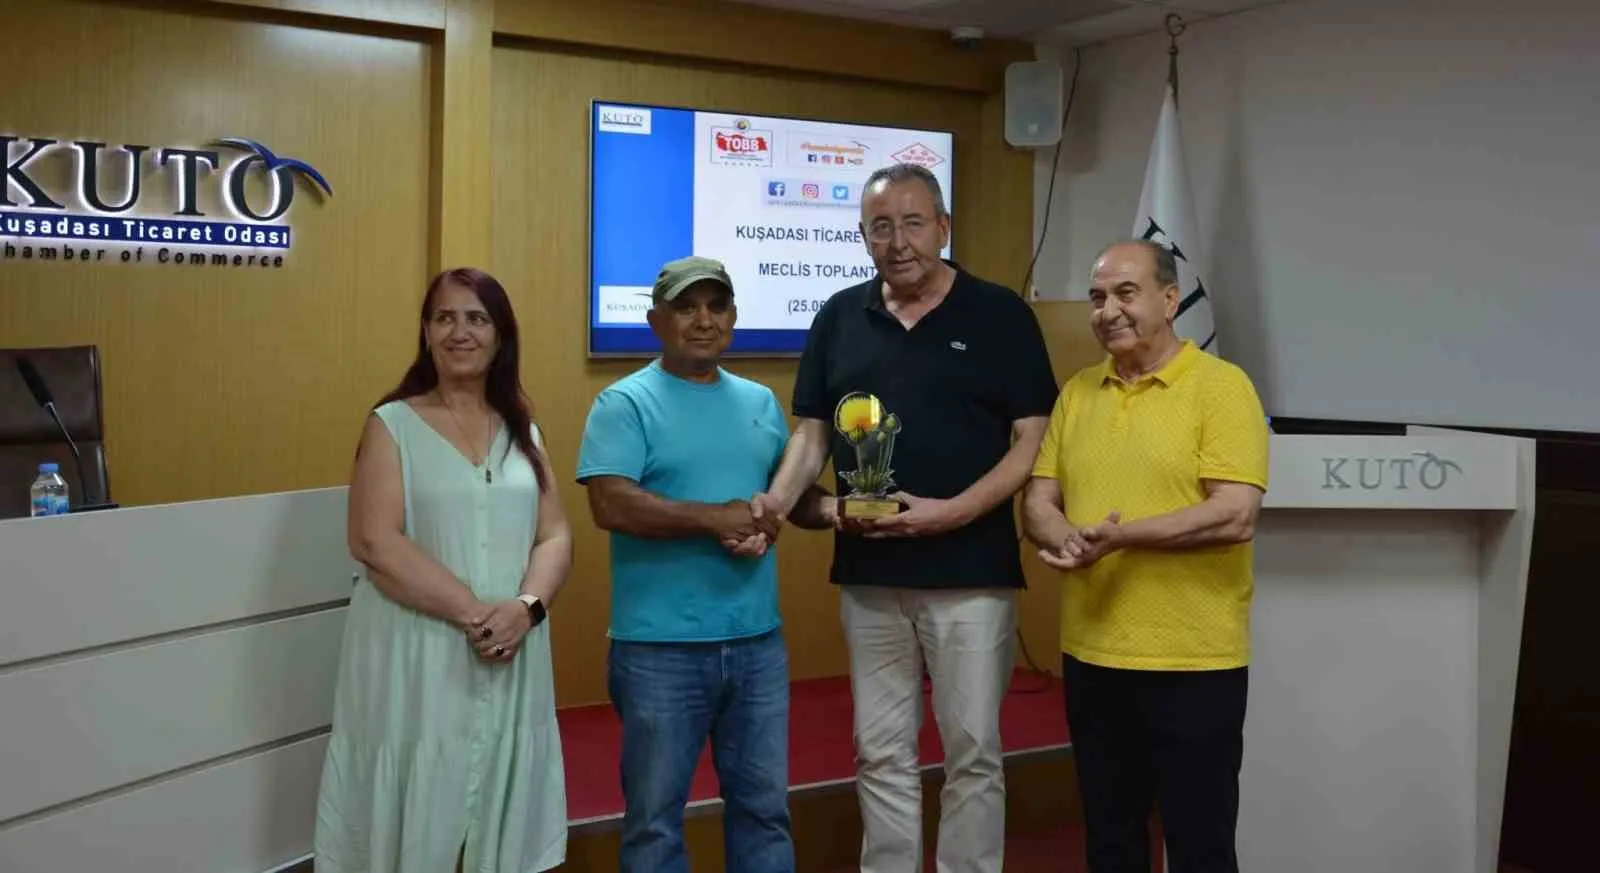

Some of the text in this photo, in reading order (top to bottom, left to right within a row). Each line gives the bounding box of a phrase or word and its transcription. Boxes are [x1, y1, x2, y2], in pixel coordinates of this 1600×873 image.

[724, 136, 759, 151] TOBB
[0, 136, 294, 221] KUTO
[0, 213, 288, 245] uşadası Ticaret Odası
[736, 225, 861, 243] KUŞADASI TİCARE
[121, 247, 142, 262] of
[158, 248, 283, 267] Commerce
[759, 260, 875, 279] MECLİS TOPLANT
[1321, 457, 1447, 490] KUTO
